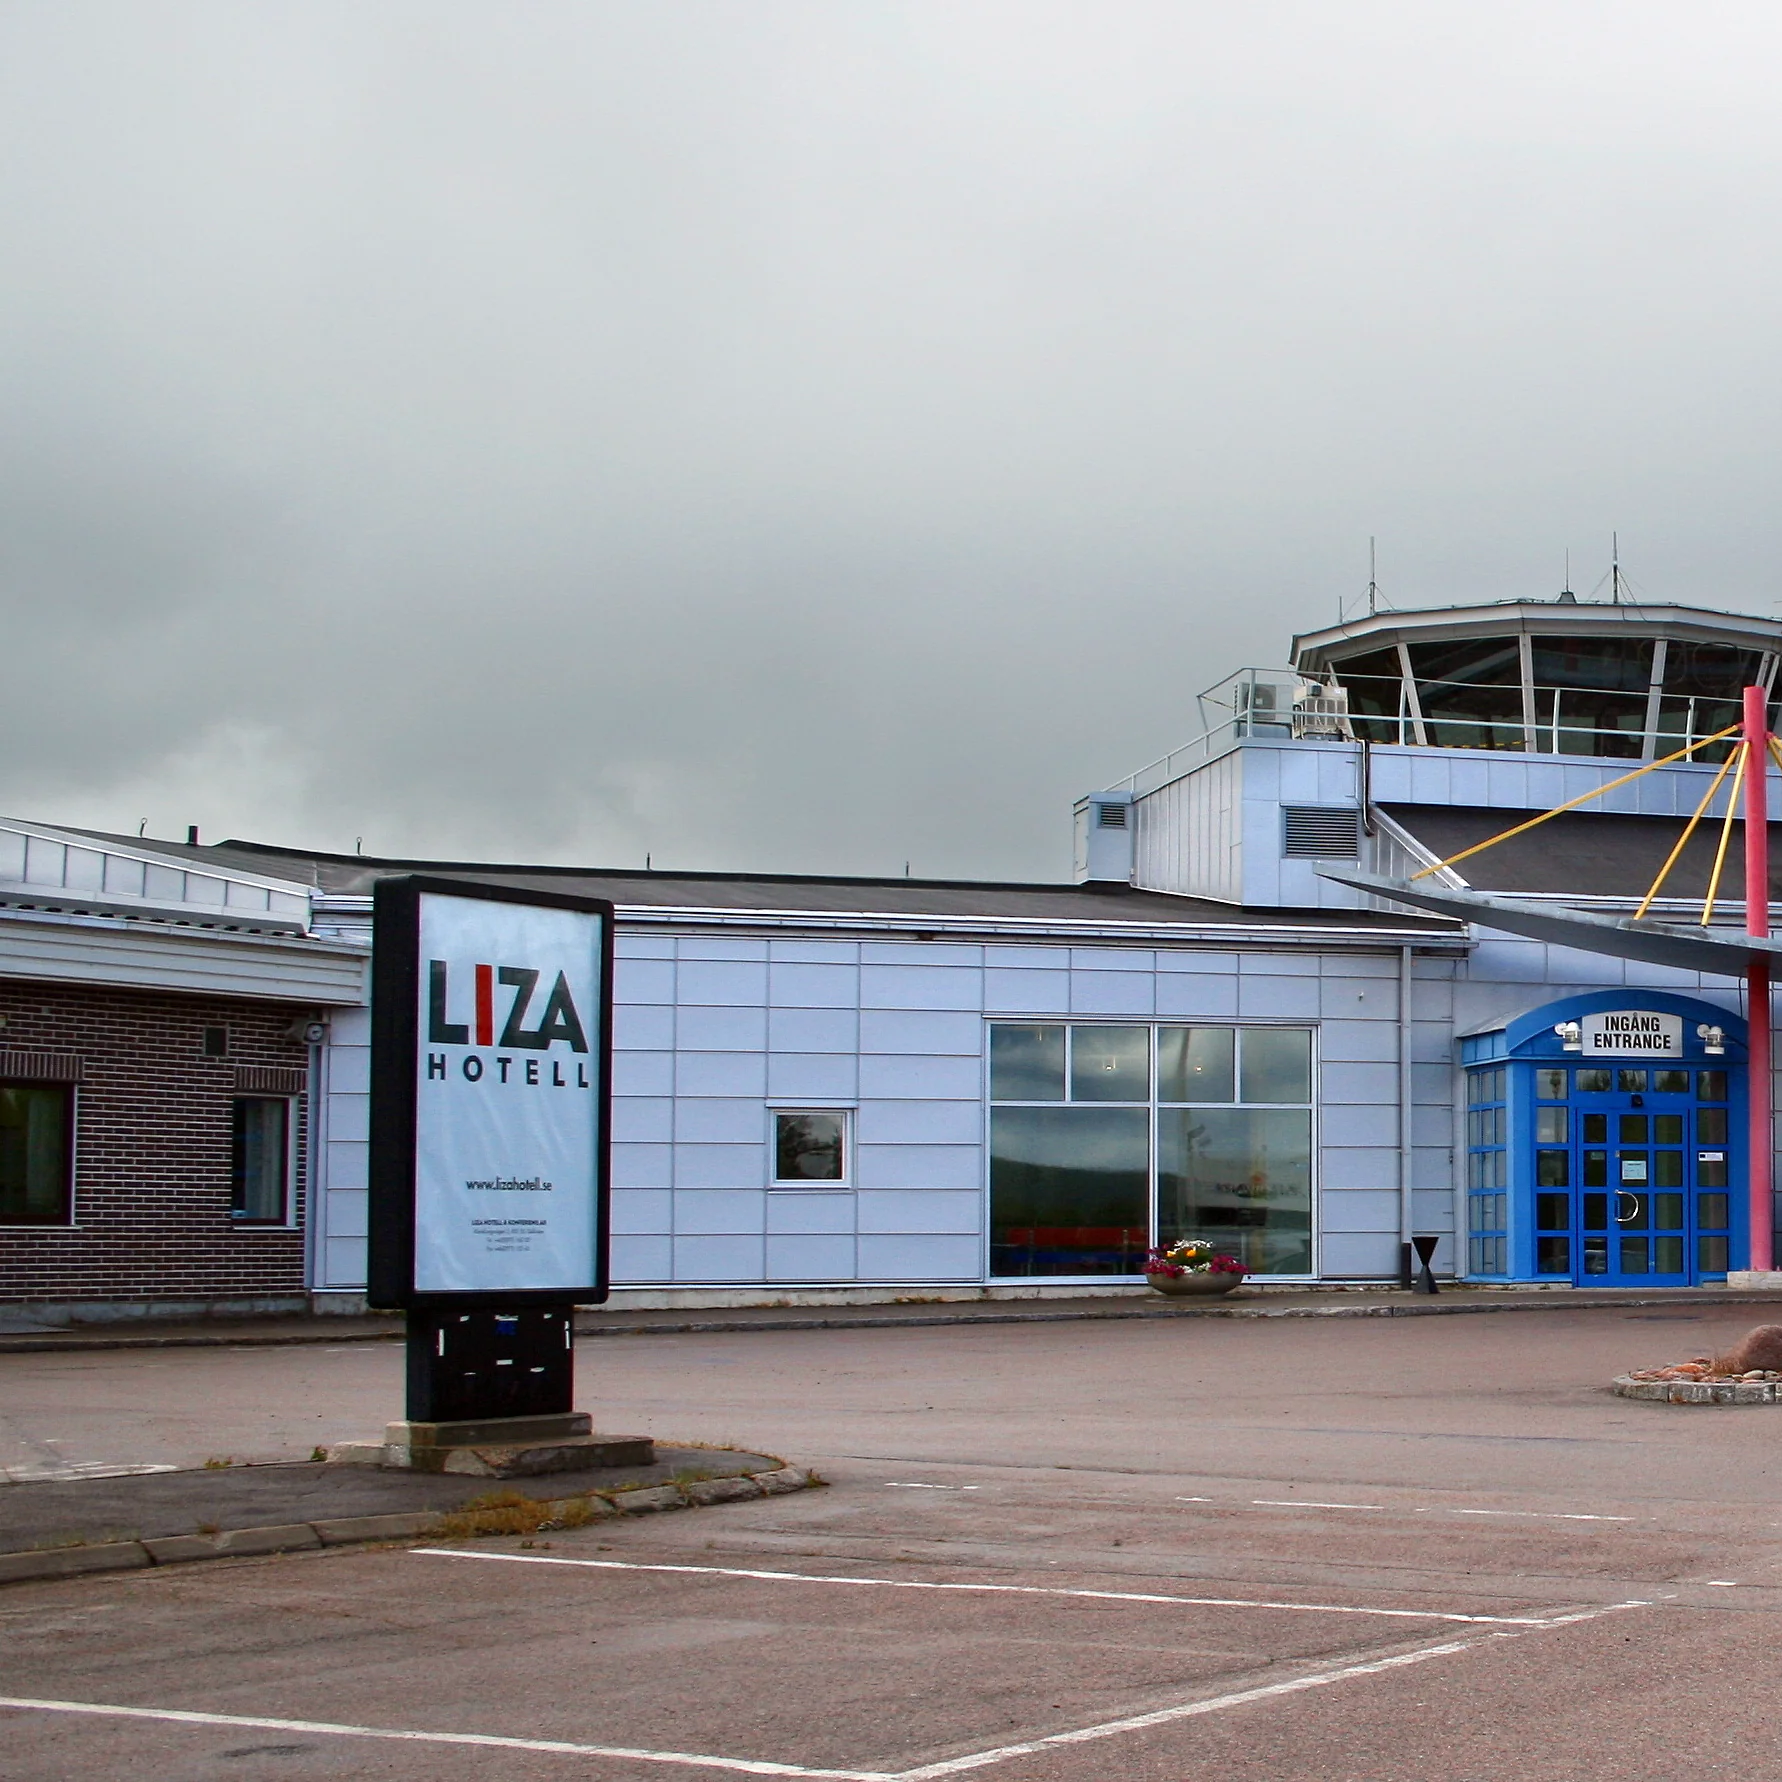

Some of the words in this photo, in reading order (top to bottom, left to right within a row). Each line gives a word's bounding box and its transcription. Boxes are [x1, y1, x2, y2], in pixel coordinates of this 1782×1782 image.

[429, 959, 589, 1053] LIZA
[1604, 1011, 1660, 1032] INGÅNG
[1594, 1033, 1672, 1050] ENTRANCE
[428, 1053, 589, 1088] HOTELL
[466, 1176, 552, 1191] www.lizahotell.se
